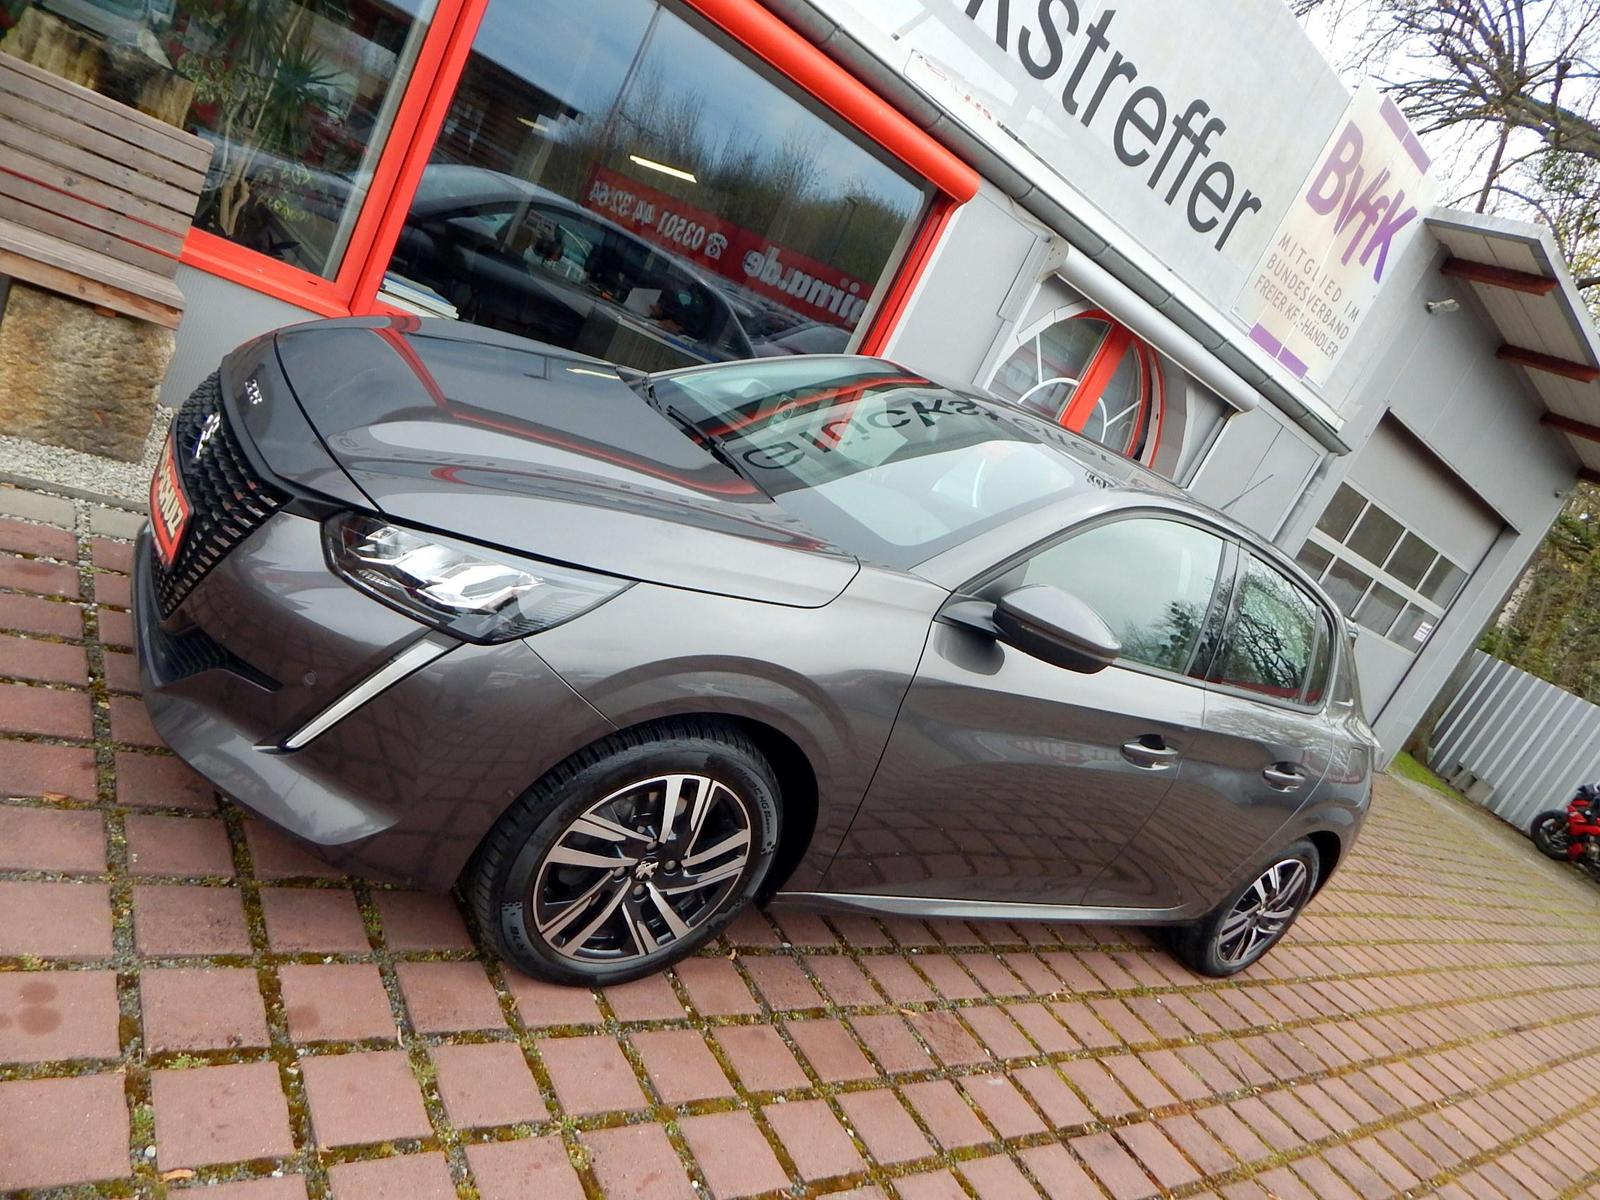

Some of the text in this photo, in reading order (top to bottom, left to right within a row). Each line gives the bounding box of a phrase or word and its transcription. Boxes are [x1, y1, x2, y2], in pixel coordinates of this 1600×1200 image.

[965, 0, 1262, 252] streffer
[1254, 274, 1288, 312] FREIER
[1266, 253, 1350, 340] BUNDESVERBAND
[1278, 232, 1360, 322] MITGLIED IM
